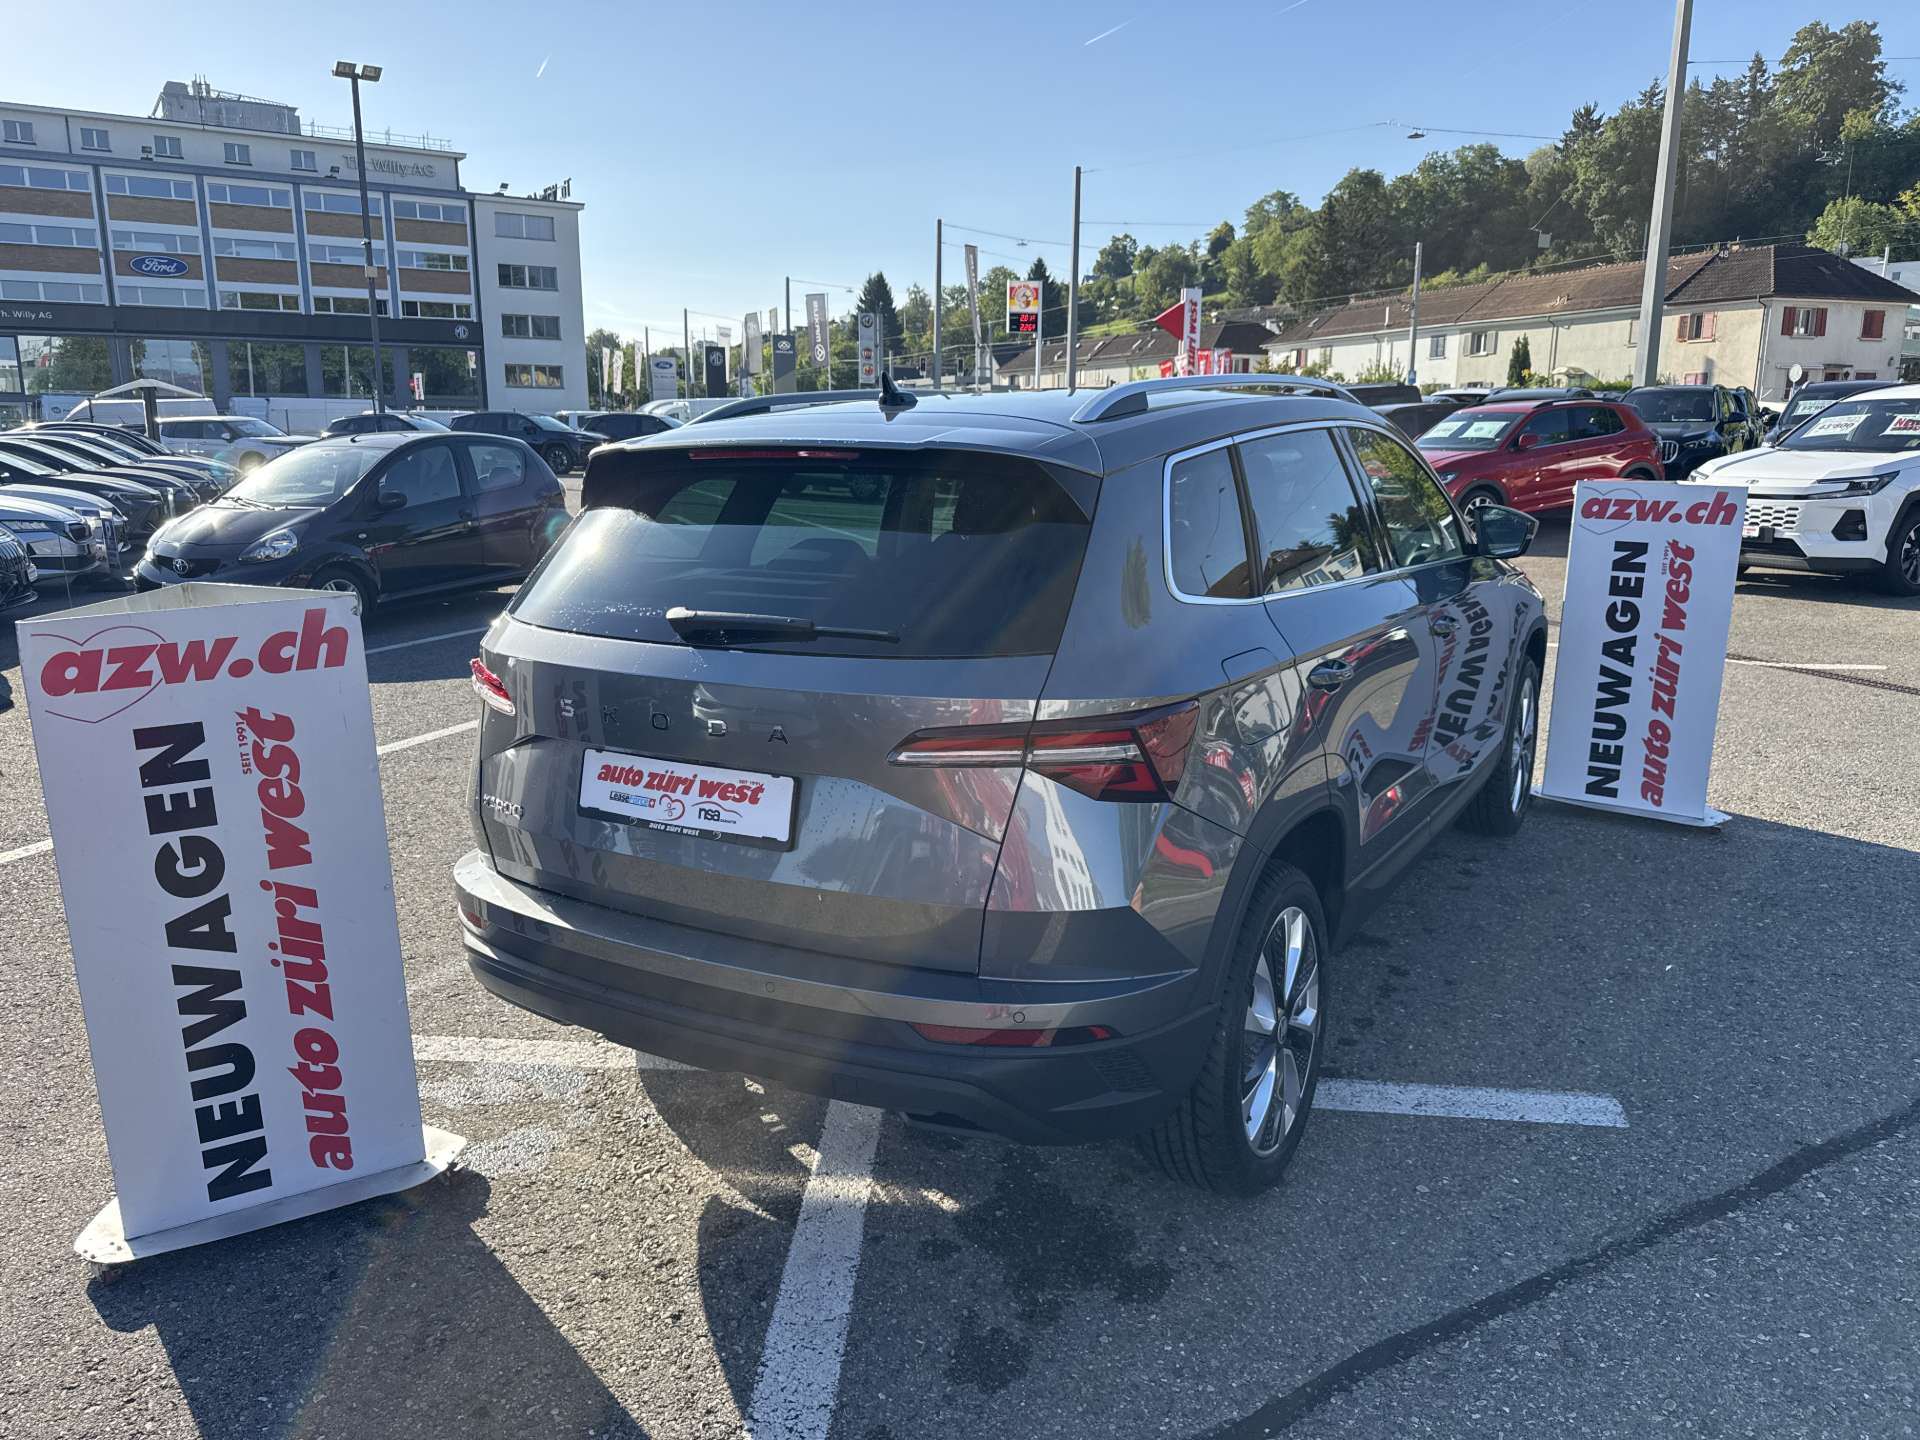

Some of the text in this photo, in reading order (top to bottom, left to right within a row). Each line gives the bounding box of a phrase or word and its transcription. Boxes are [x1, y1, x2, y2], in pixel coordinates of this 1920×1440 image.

[371, 158, 408, 177] Willy
[412, 163, 436, 178] AG
[141, 257, 177, 273] Ford
[13, 311, 36, 320] Willy
[38, 311, 53, 319] AG
[1581, 491, 1738, 525] azw.ch
[40, 608, 349, 697] azw.ch
[1585, 540, 1649, 799] NEUWAGEN
[1640, 539, 1695, 807] auto züri west
[237, 720, 253, 775] SEIT 1991
[597, 763, 765, 805] auto züri west
[697, 807, 721, 822] nsa
[133, 721, 273, 1203] NEUWAGEN
[234, 706, 354, 1171] auto züri west
